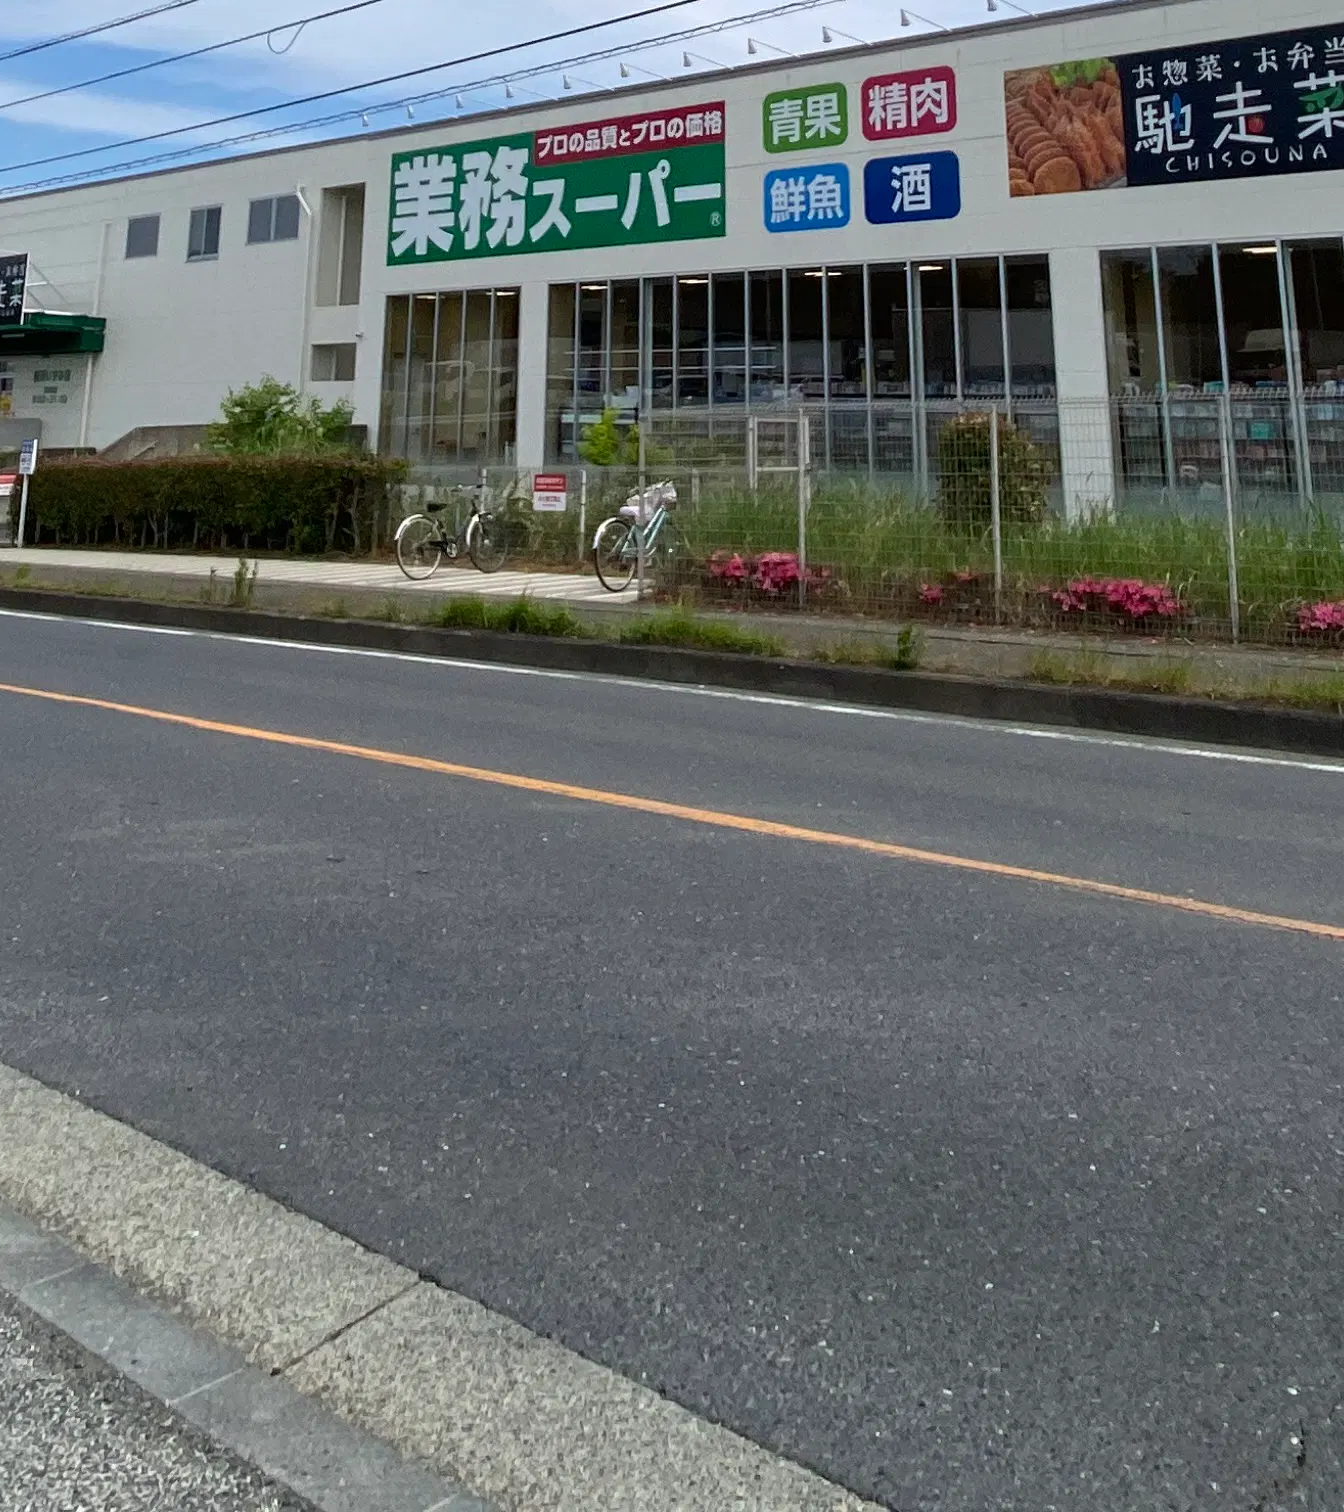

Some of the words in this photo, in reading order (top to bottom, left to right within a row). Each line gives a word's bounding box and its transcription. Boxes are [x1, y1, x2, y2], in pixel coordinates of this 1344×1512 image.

[767, 92, 842, 145] 青果
[867, 76, 950, 132] 精肉
[537, 110, 723, 159] プロの品質とプロの価格
[1165, 143, 1328, 173] CHISOUNA
[391, 145, 722, 257] 業務スーパー
[769, 173, 845, 224] 鮮魚
[890, 163, 932, 215] 酒
